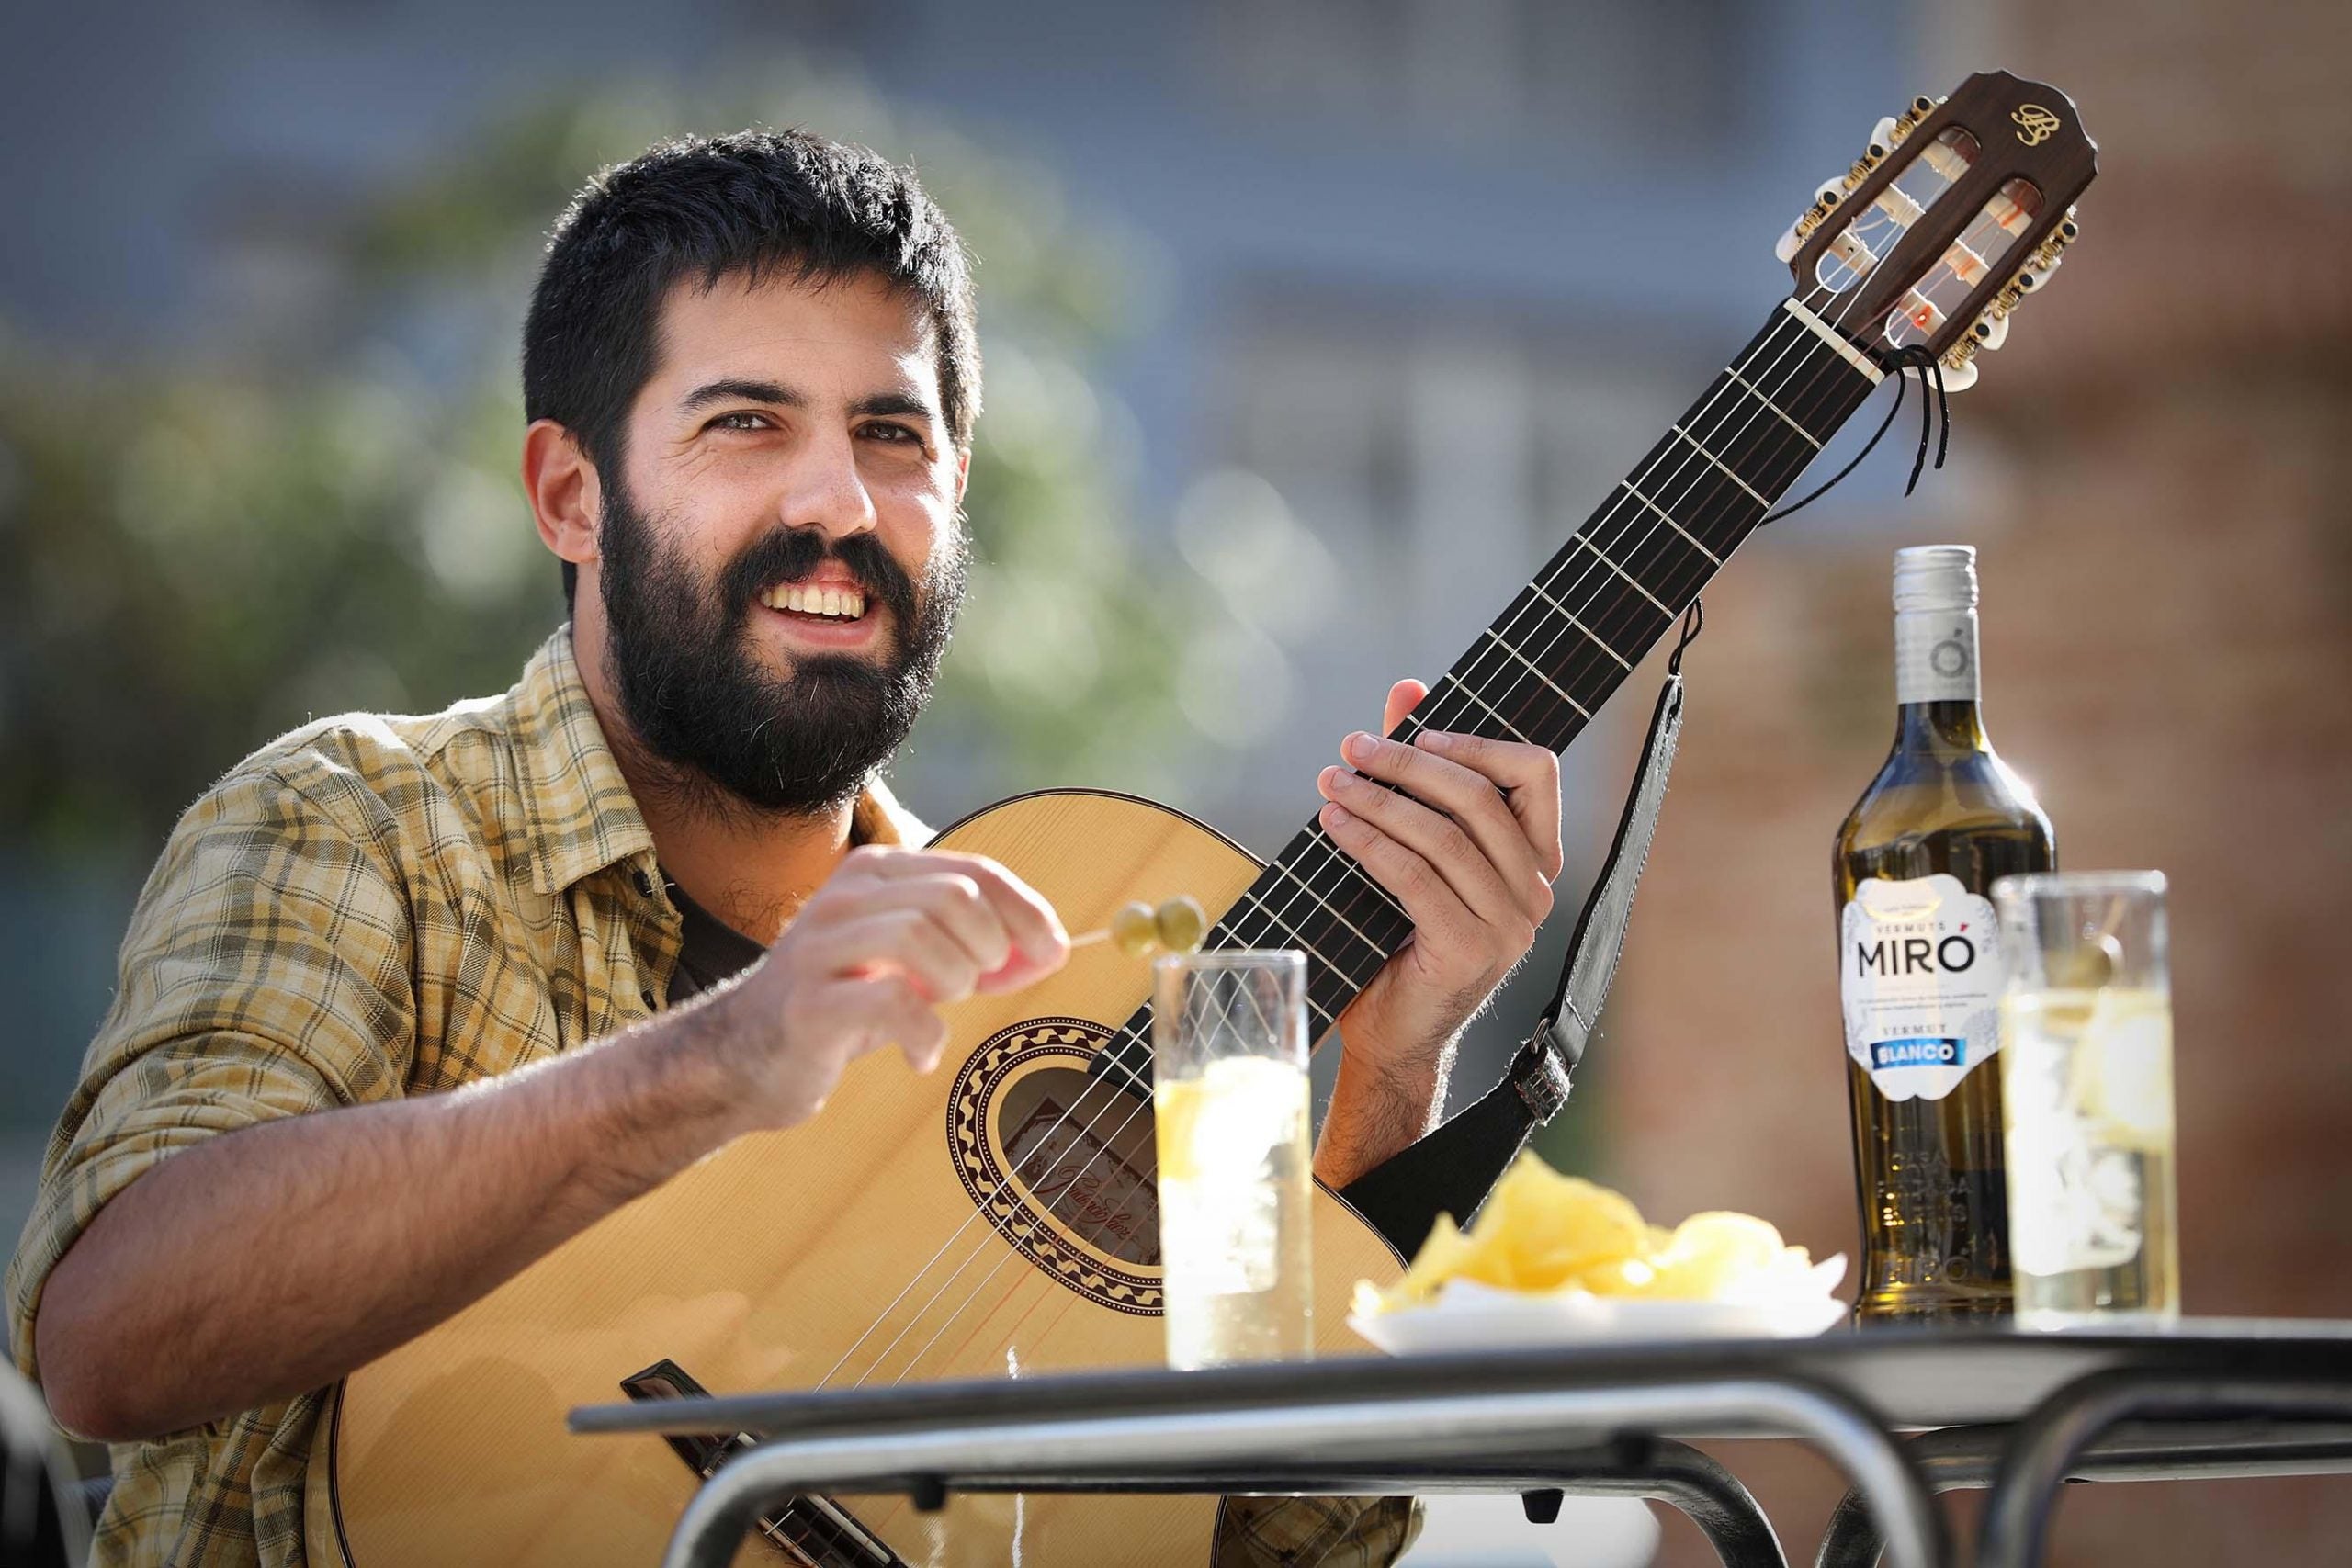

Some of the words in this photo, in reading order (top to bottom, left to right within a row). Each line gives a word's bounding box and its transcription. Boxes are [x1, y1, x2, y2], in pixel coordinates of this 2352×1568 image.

[1877, 922, 1947, 934] VERMUTS
[1858, 922, 1975, 976] MIRÓ
[1883, 1023, 1947, 1036] VERMUT
[1877, 1043, 1955, 1065] BLANCO
